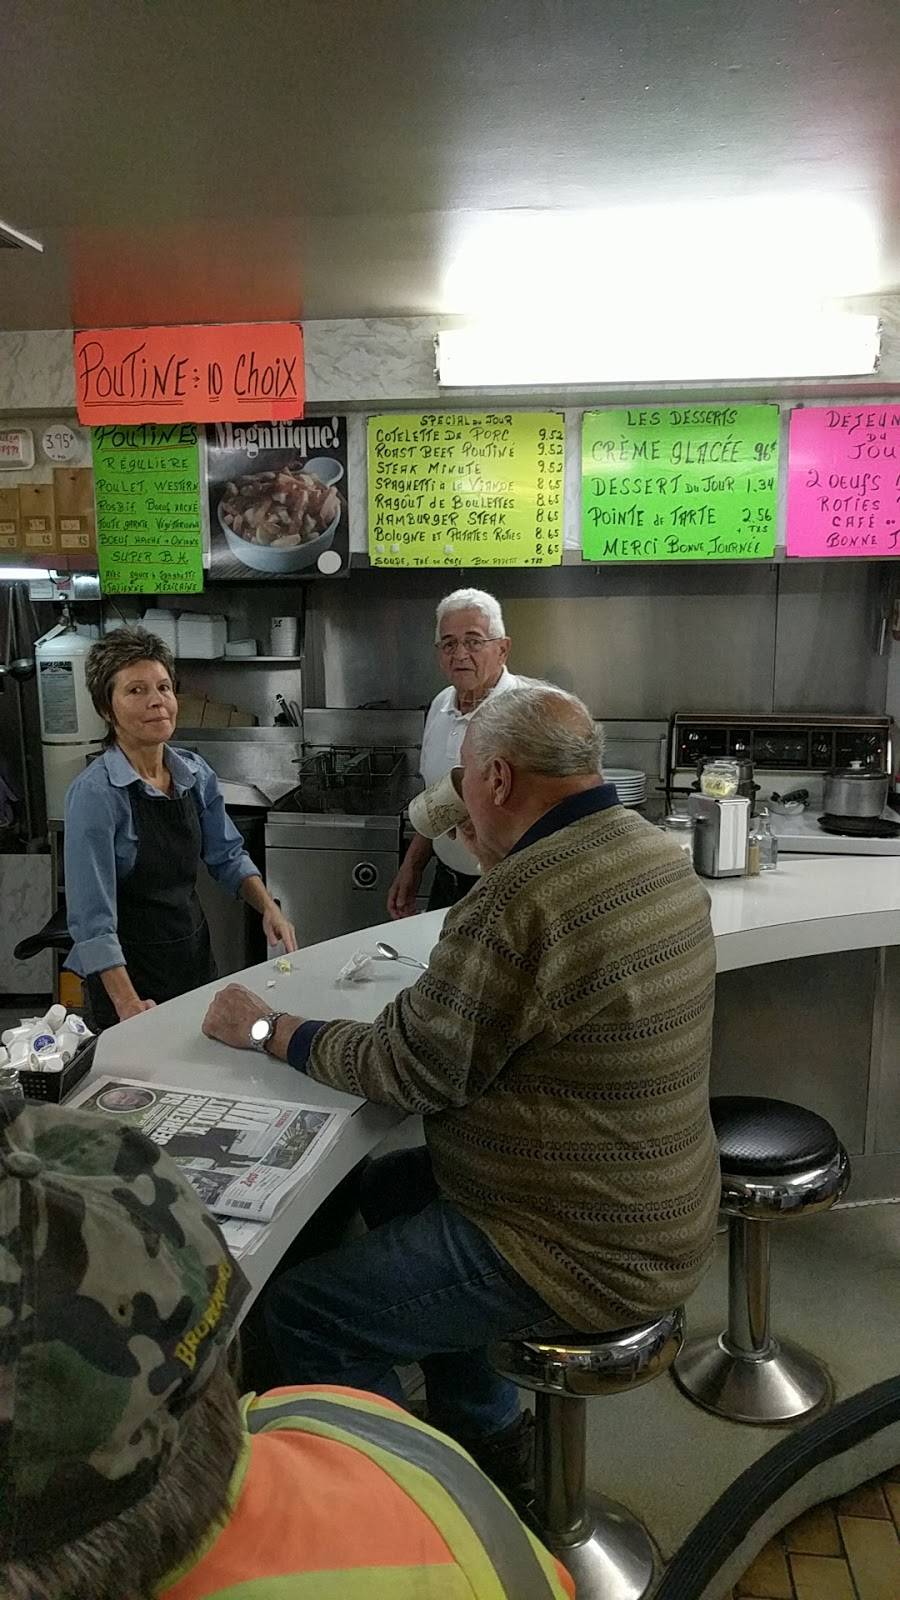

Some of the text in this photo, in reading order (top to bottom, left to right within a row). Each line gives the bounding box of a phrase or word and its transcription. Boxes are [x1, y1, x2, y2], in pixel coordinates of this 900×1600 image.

[208, 362, 223, 396] 10
[486, 415, 513, 425] JOUR
[627, 408, 738, 426] LES DESSERTS
[94, 424, 197, 449] POUTINES
[215, 416, 339, 458] Magnifique!
[469, 428, 510, 441] PORC
[539, 429, 563, 440] 9.52
[867, 433, 886, 442] DU
[375, 443, 417, 458] ROAST
[420, 446, 455, 458] BEEF
[538, 443, 563, 455] 9.52
[592, 435, 660, 462] CRÈME
[376, 460, 563, 474] STEAK MINUTE 9.52
[538, 479, 561, 490] 8.65
[591, 474, 682, 496] DESSERT
[702, 475, 735, 492] JOUR
[747, 477, 774, 493] 1.34
[807, 469, 822, 487] 2
[452, 495, 515, 509] BOULETTES
[537, 495, 560, 506] 8.65
[376, 509, 559, 526] HAMBURGER STEAK 8.65
[588, 505, 644, 527] POINTE
[670, 505, 716, 527] TARTE
[742, 508, 772, 524] 2.56
[833, 514, 875, 528] CAFÉ
[536, 528, 559, 539] 8.65
[826, 532, 878, 547] BONNE
[536, 544, 559, 555] 8.65
[603, 538, 657, 556] MERCI
[112, 551, 152, 561] SUPER
